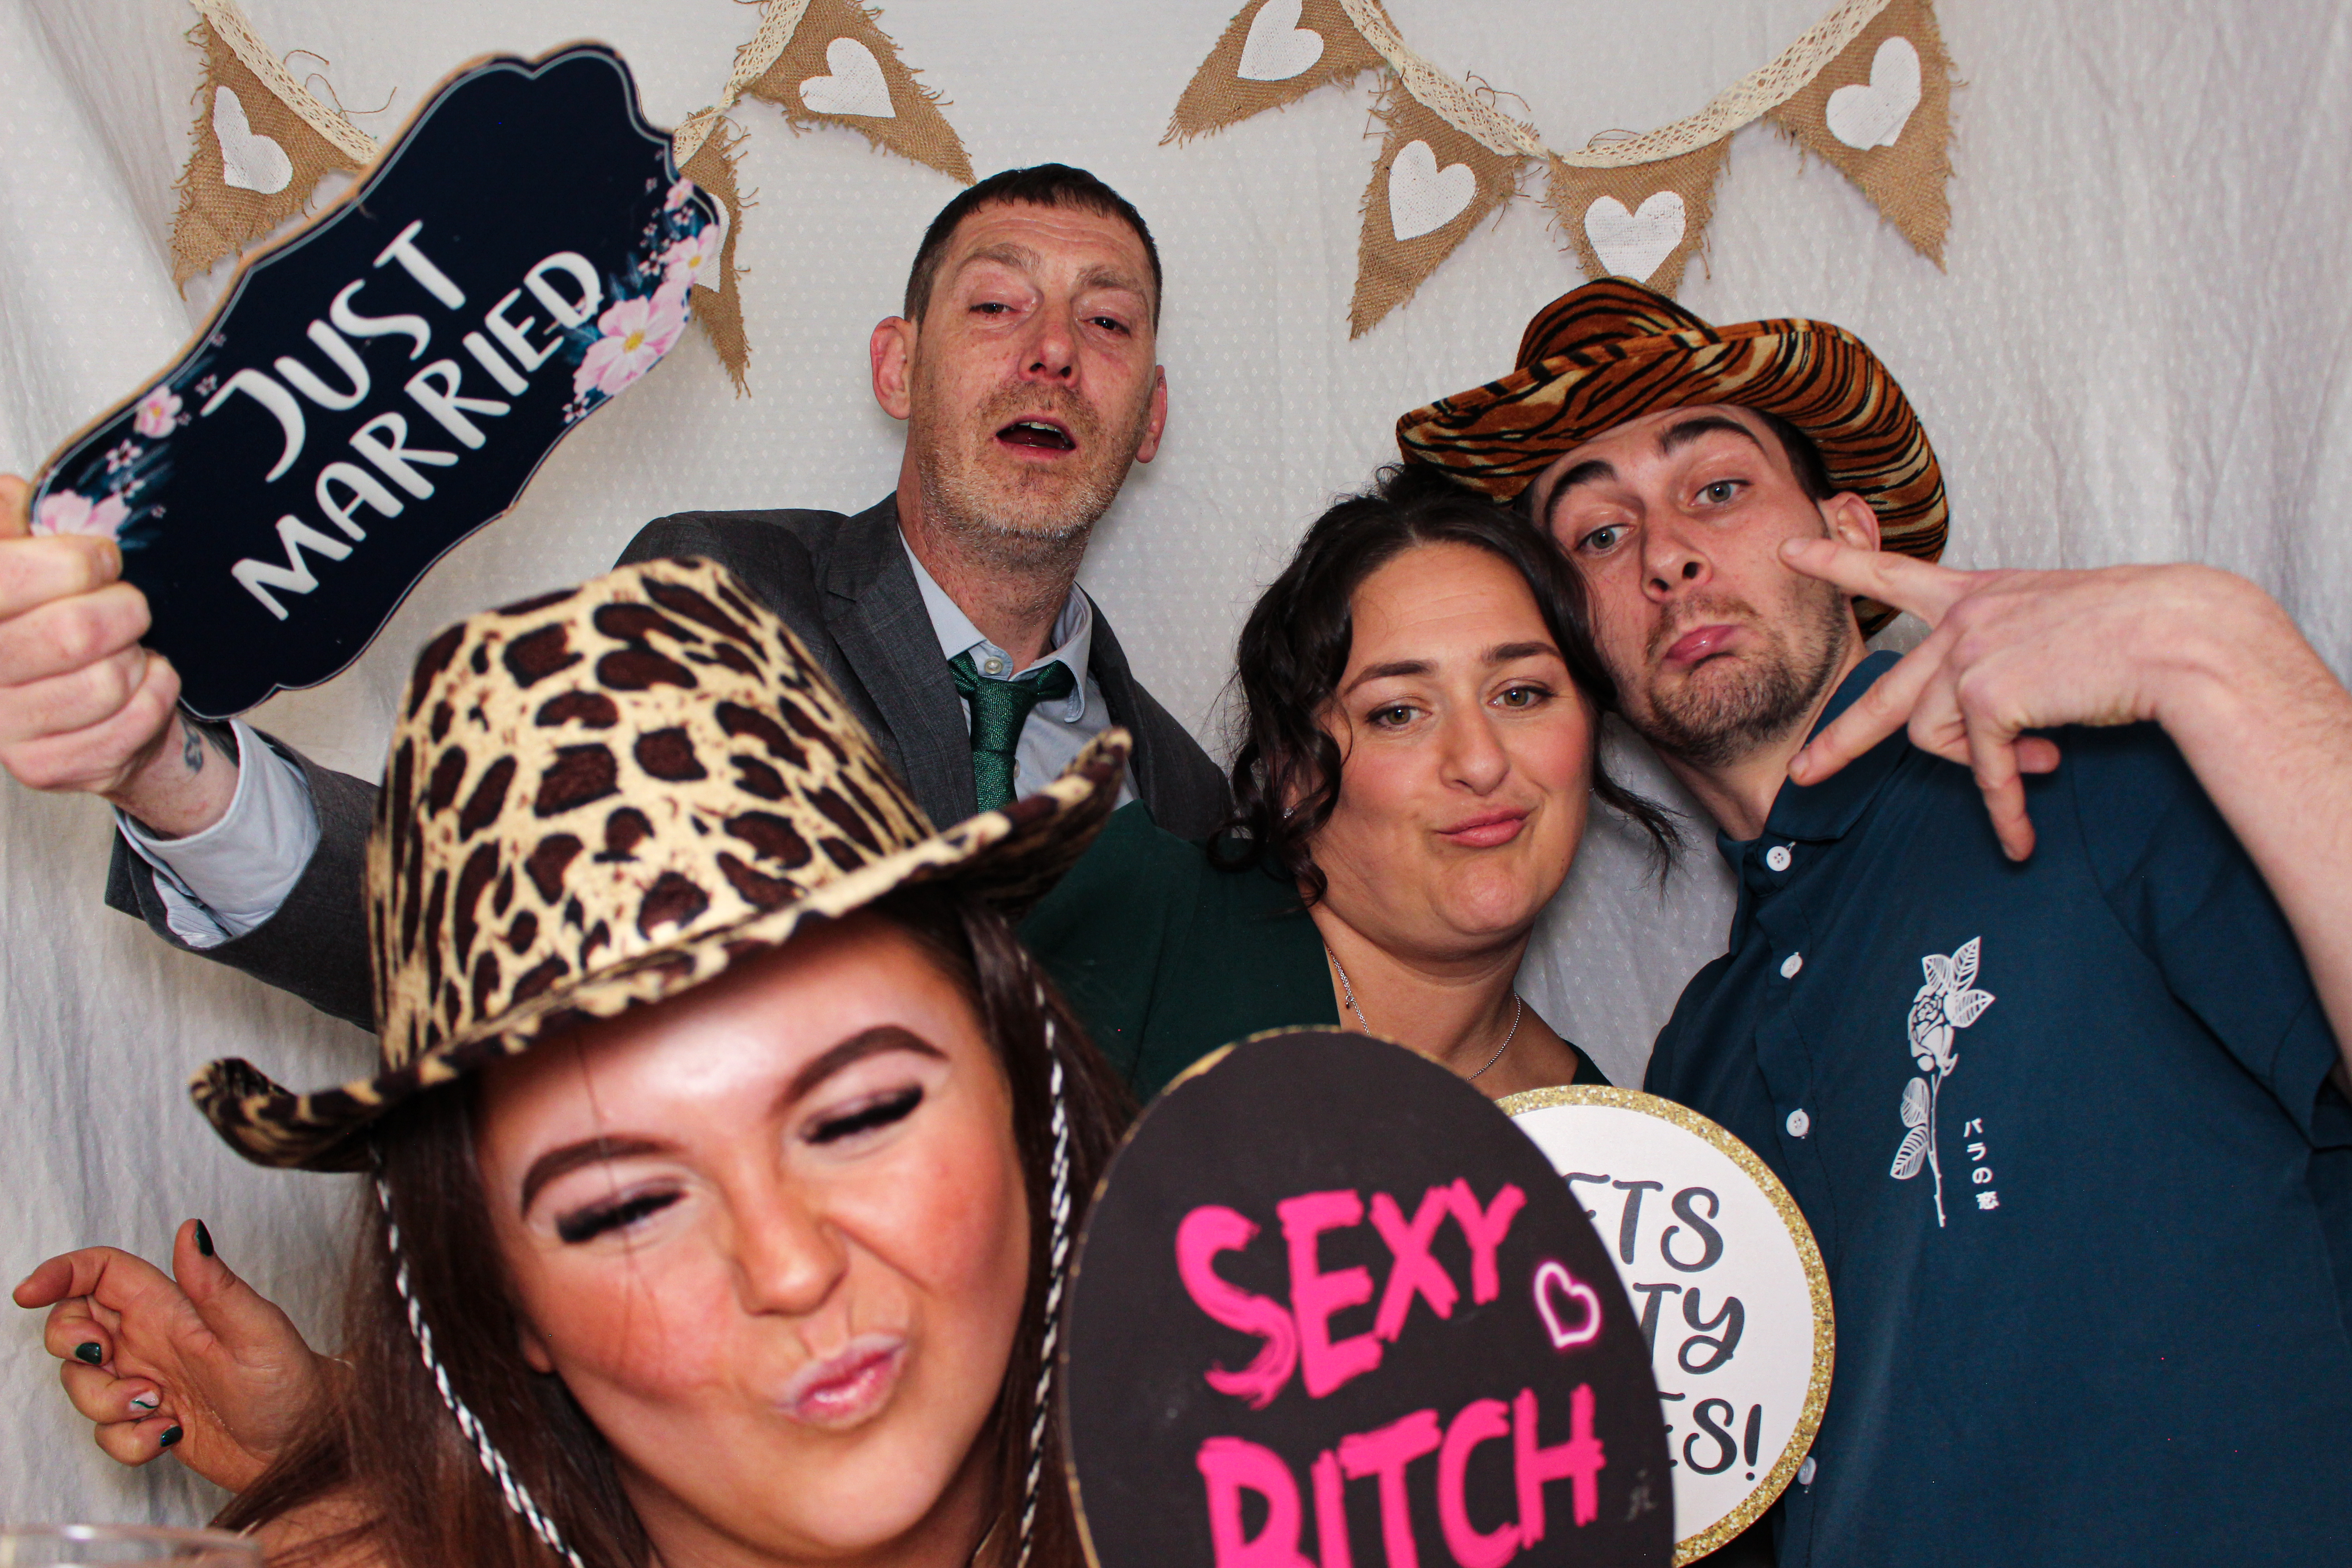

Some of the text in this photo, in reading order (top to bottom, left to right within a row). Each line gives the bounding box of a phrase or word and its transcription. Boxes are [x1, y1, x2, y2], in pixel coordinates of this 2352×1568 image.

[200, 220, 466, 482] JUST
[231, 251, 603, 620] MARRIED
[1175, 1177, 1527, 1409] SEXY
[1632, 1282, 1745, 1375] TY
[1196, 1383, 1607, 1568] BITCH
[1658, 1391, 1762, 1481] S!
